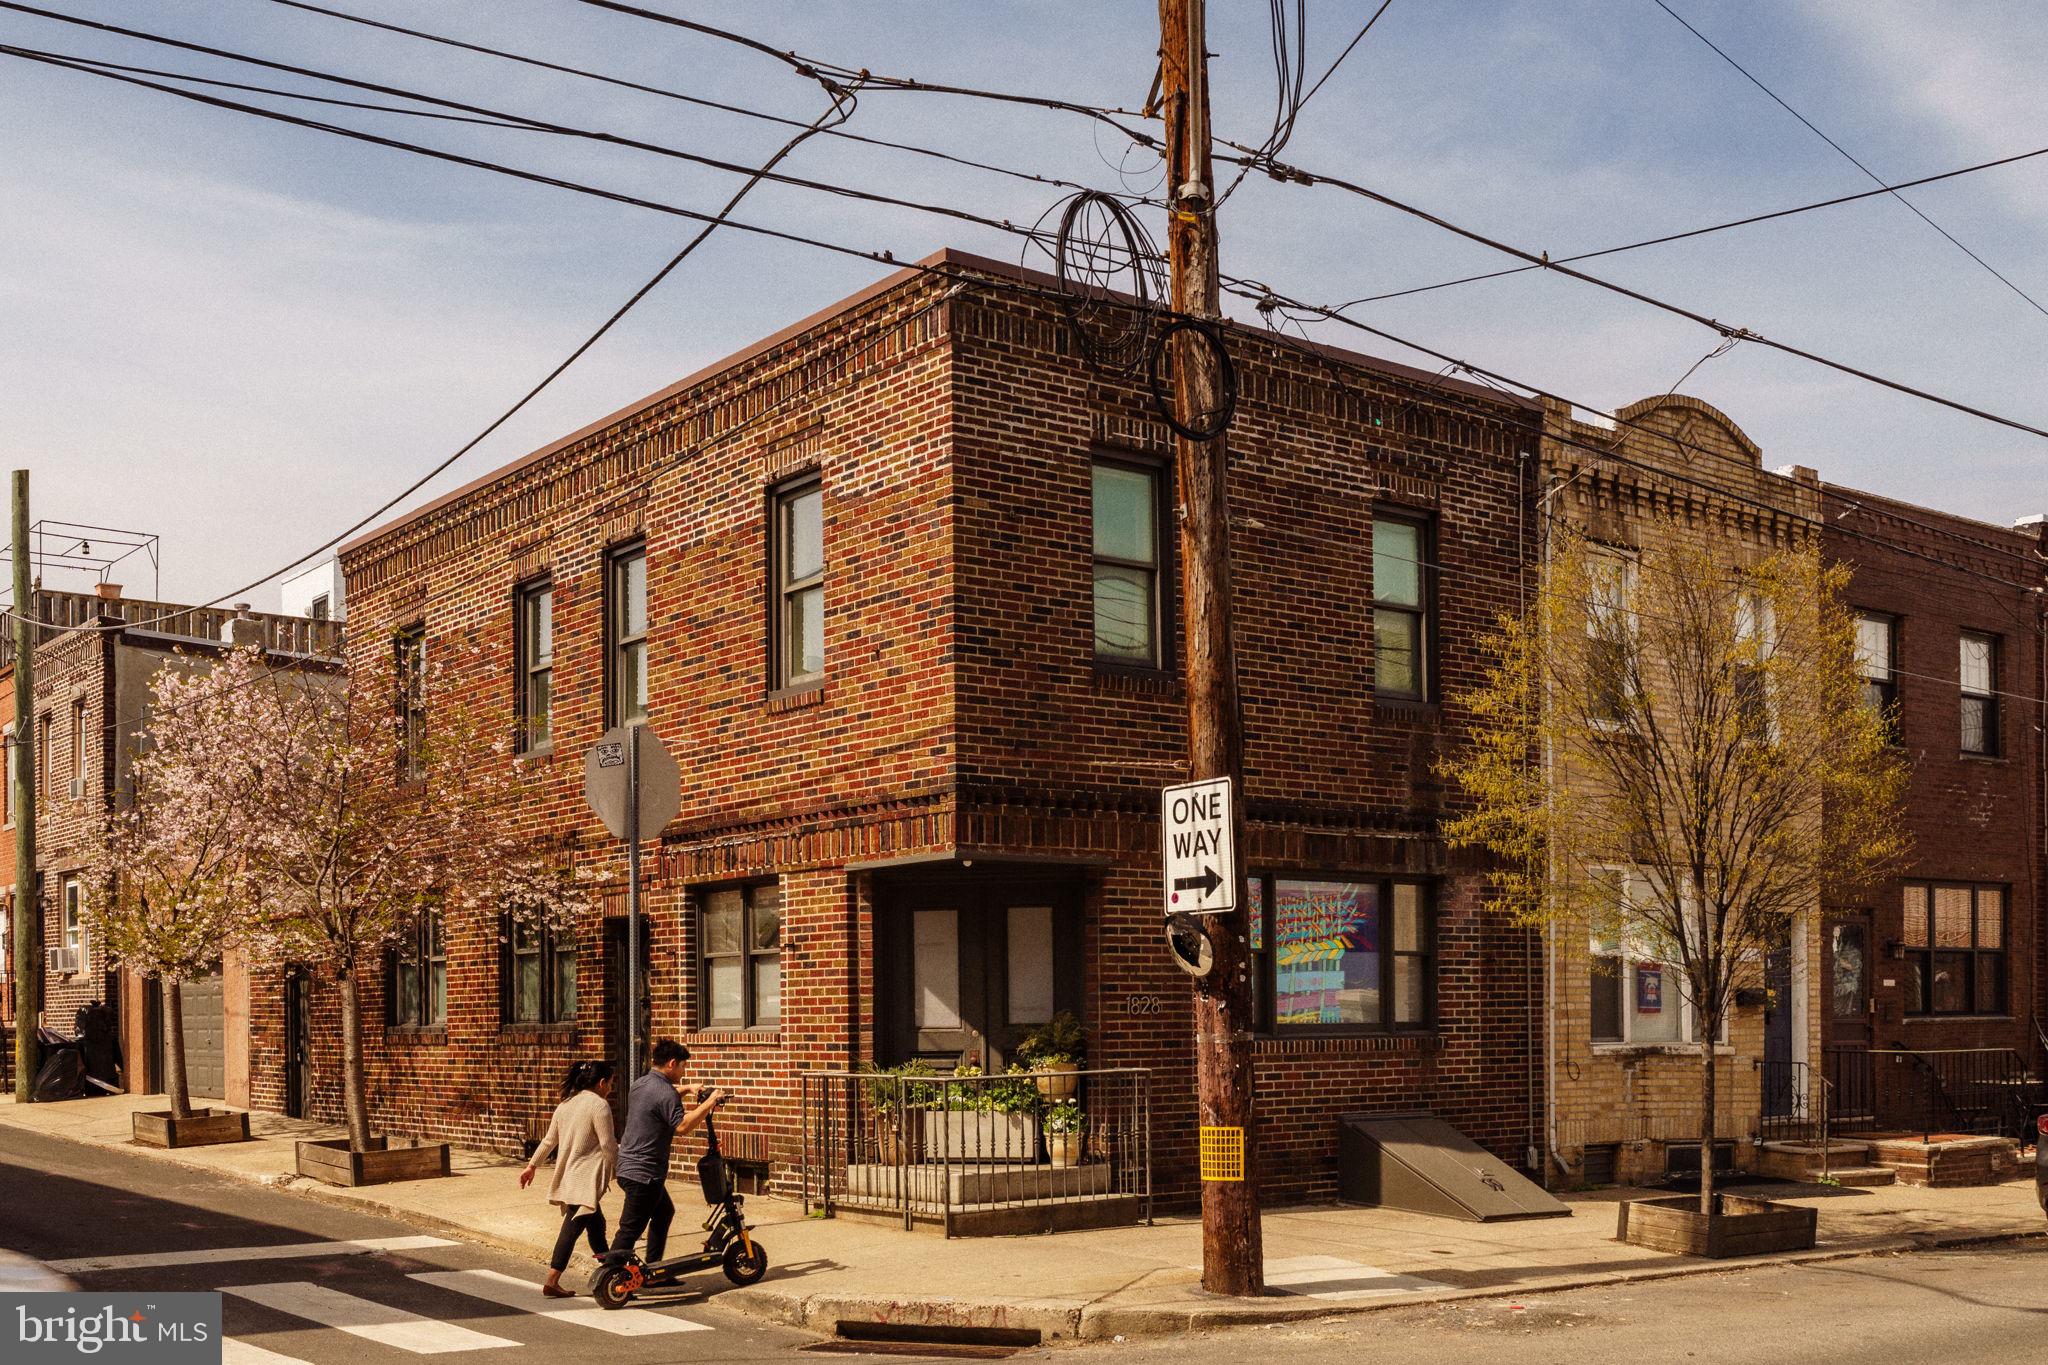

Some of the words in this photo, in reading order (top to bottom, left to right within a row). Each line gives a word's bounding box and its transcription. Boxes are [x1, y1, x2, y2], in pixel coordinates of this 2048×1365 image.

[1172, 793, 1222, 824] ONE
[1173, 828, 1222, 859] WAY
[1126, 996, 1161, 1015] 1828
